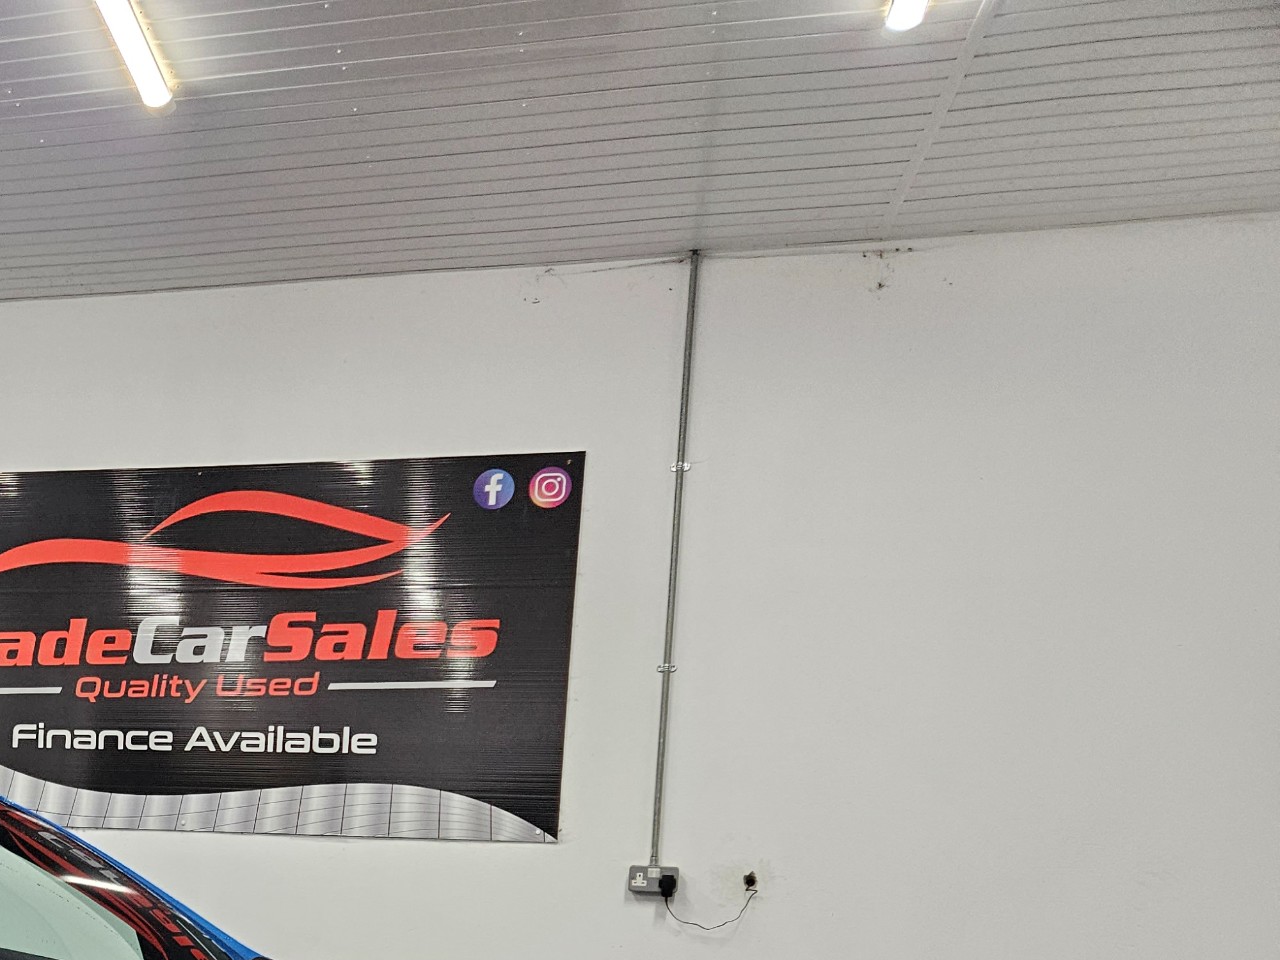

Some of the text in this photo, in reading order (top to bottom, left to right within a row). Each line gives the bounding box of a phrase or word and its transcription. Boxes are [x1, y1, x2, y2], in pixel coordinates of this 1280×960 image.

[75, 671, 320, 703] Quality Used
[12, 723, 378, 755] Finance Available
